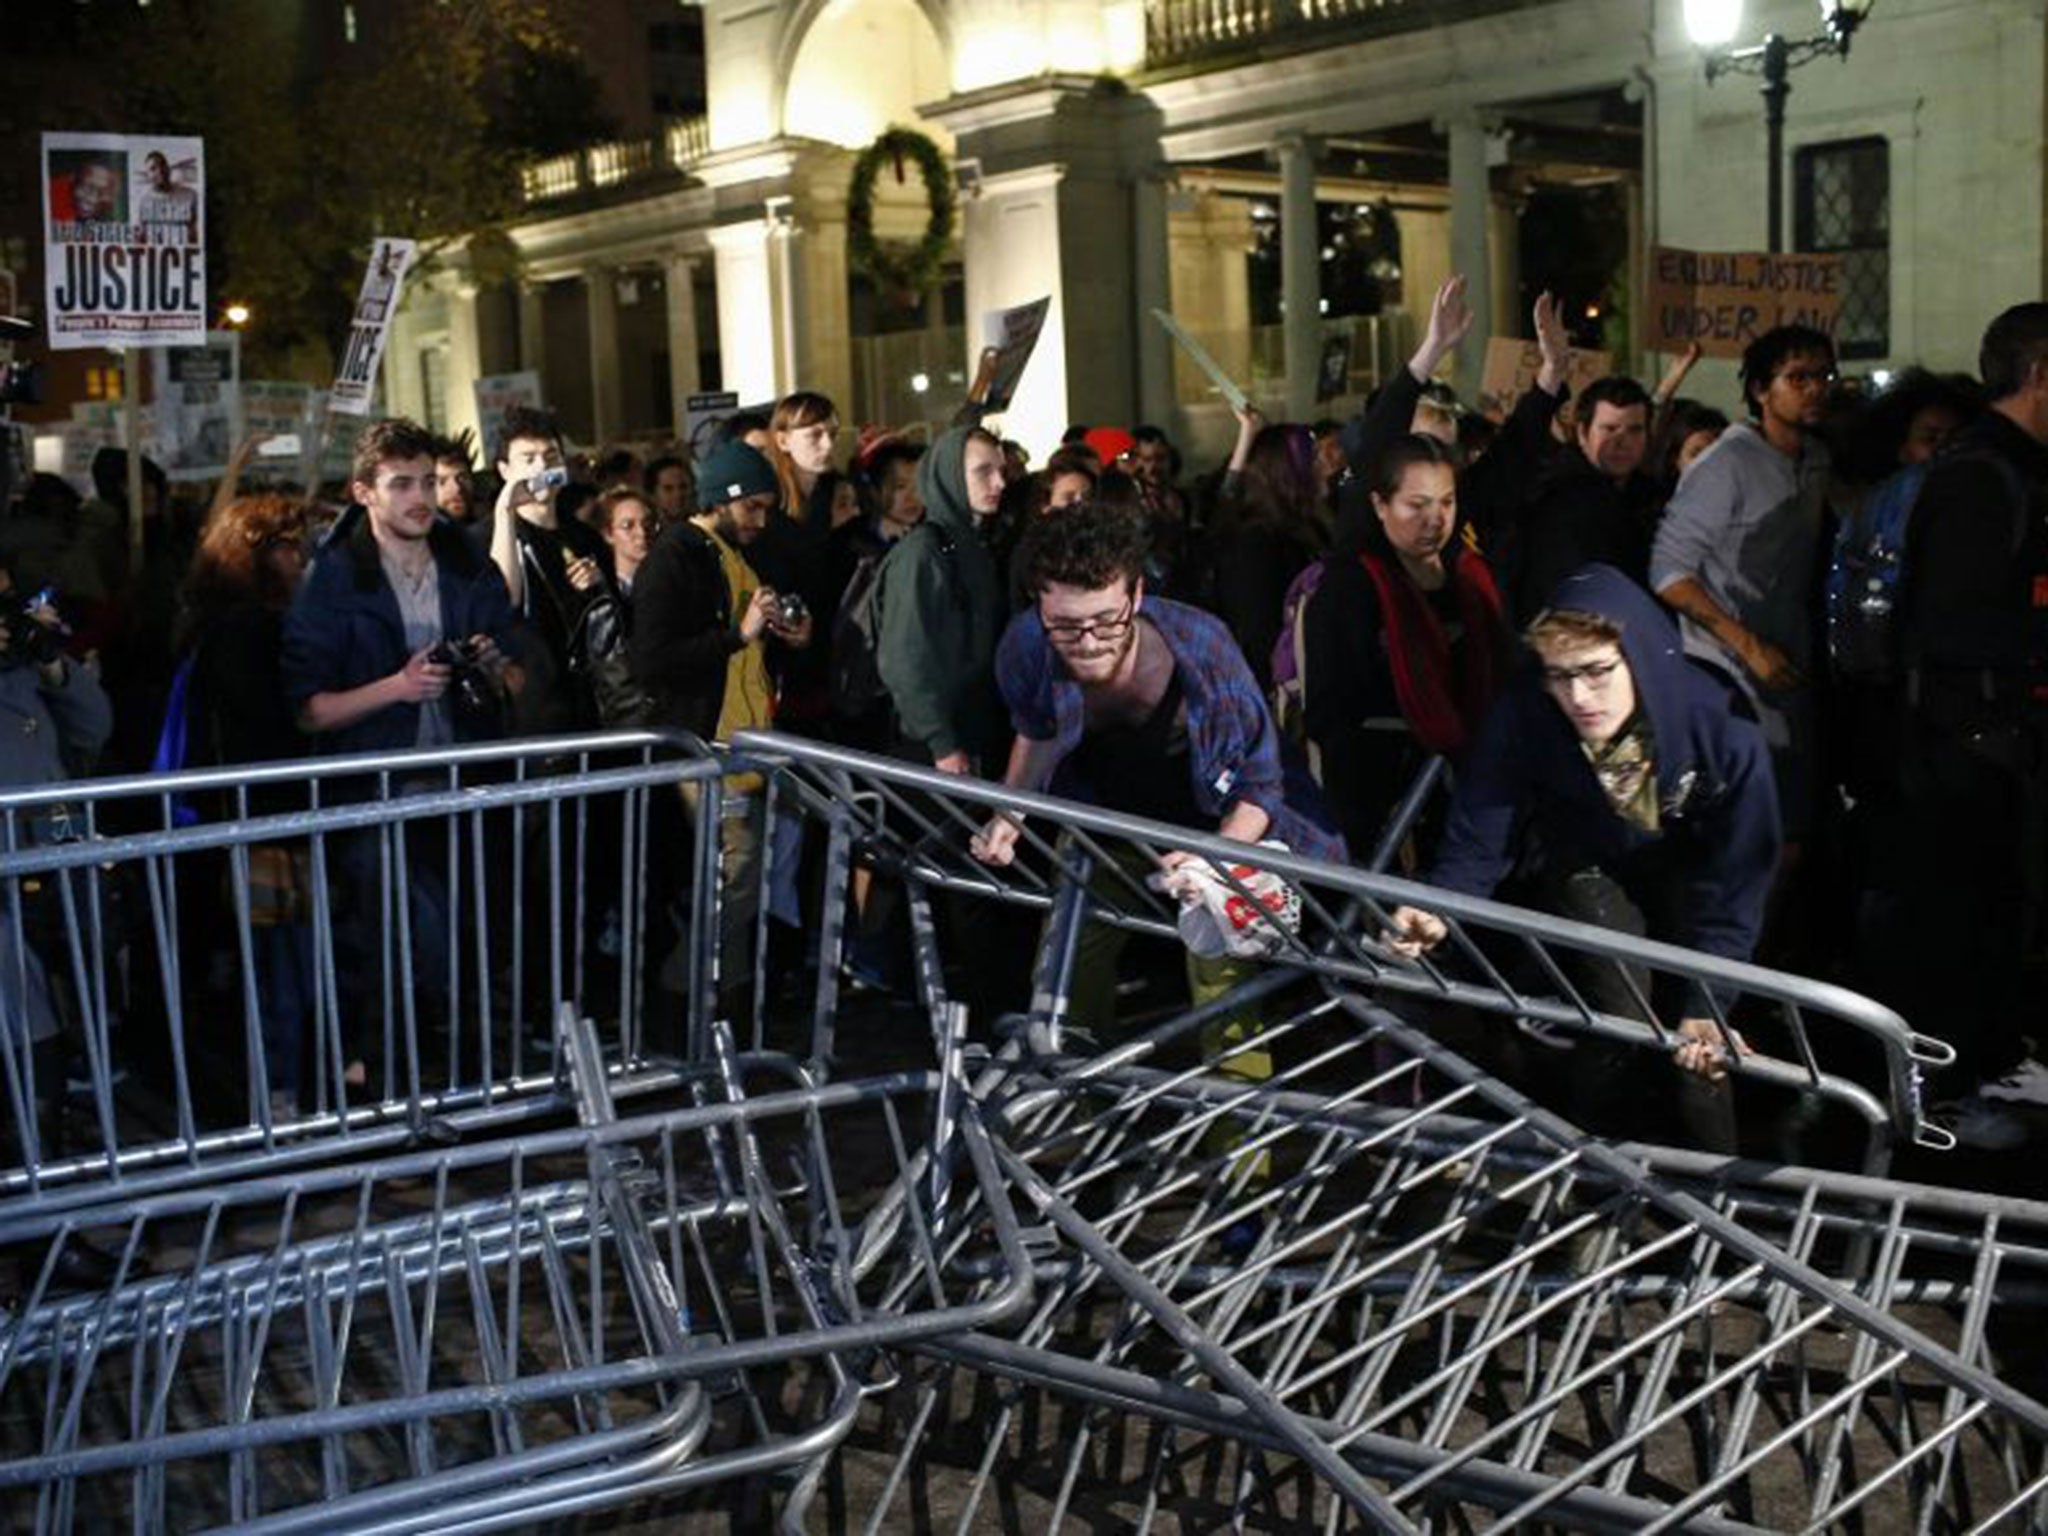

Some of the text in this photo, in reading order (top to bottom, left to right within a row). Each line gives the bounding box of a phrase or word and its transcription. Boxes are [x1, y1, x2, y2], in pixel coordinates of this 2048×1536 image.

[55, 245, 201, 311] JUSTICE
[1658, 254, 1838, 293] EQUAL JUSTICE
[1659, 304, 1759, 342] UNDER
